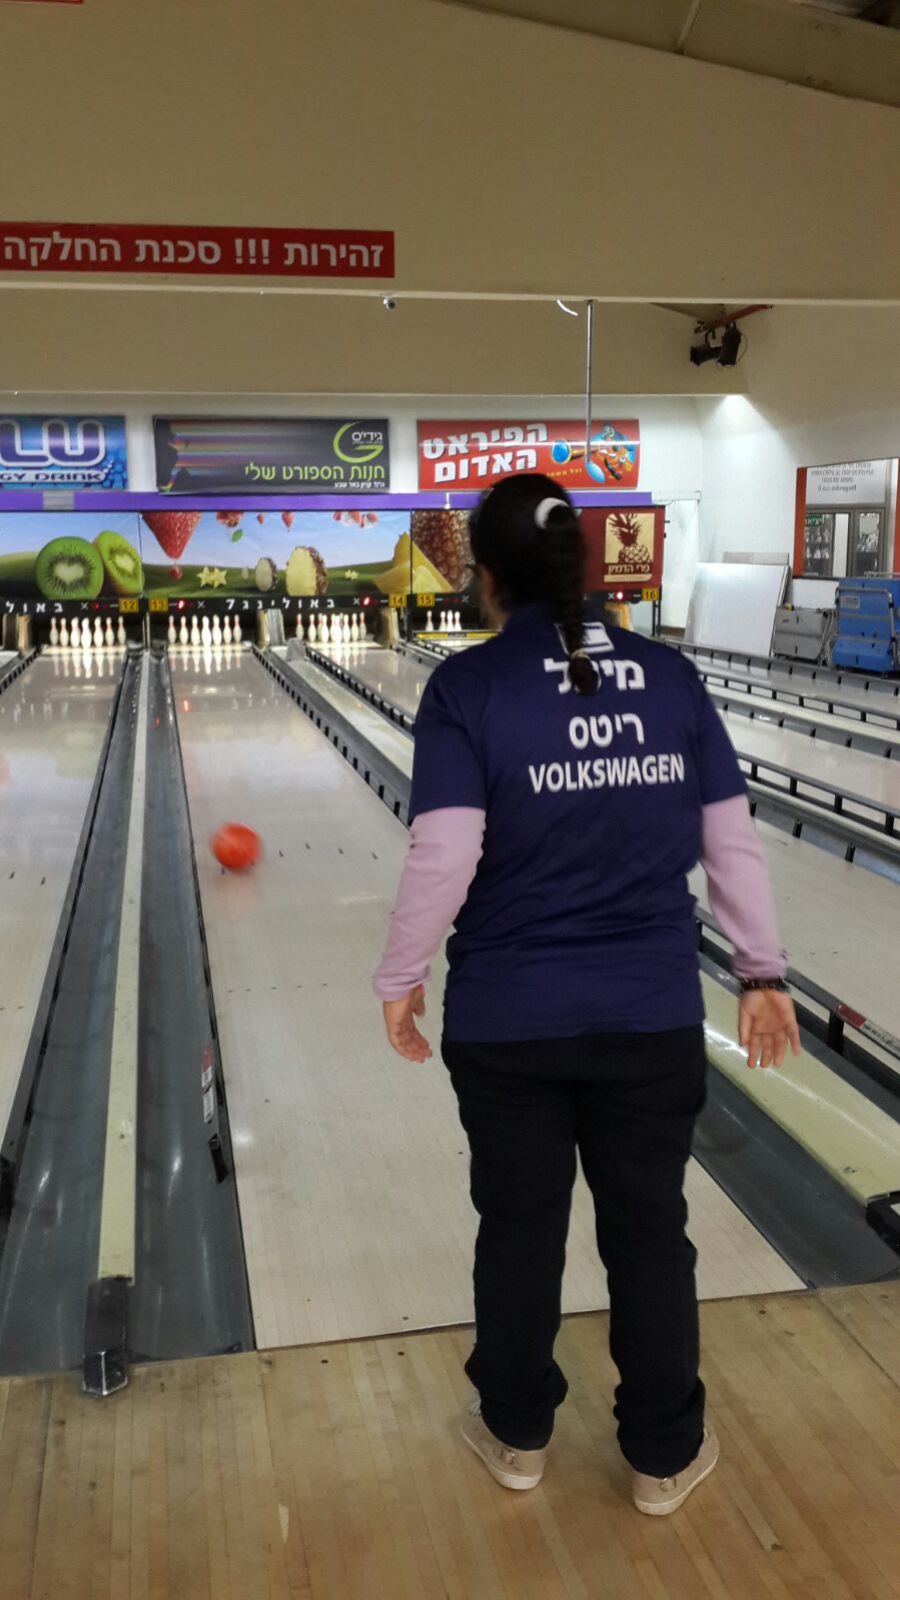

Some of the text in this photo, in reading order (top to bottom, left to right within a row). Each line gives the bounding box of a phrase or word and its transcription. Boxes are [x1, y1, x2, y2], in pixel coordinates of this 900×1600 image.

[3, 230, 122, 267] החלקה
[135, 237, 222, 265] סכנת
[283, 241, 385, 268] זהירות
[422, 423, 548, 460] הפיראט
[244, 461, 385, 481] חנות הספורט שלי
[434, 448, 537, 484] האדום
[636, 563, 650, 573] פרי
[121, 600, 135, 611] 12
[150, 600, 166, 611] 13
[391, 594, 405, 605] 14
[418, 594, 433, 605] 15
[645, 589, 657, 599] 16
[543, 657, 646, 694] מיל
[568, 712, 645, 750] ריטס
[528, 752, 686, 795] VOLKSWAGEN
